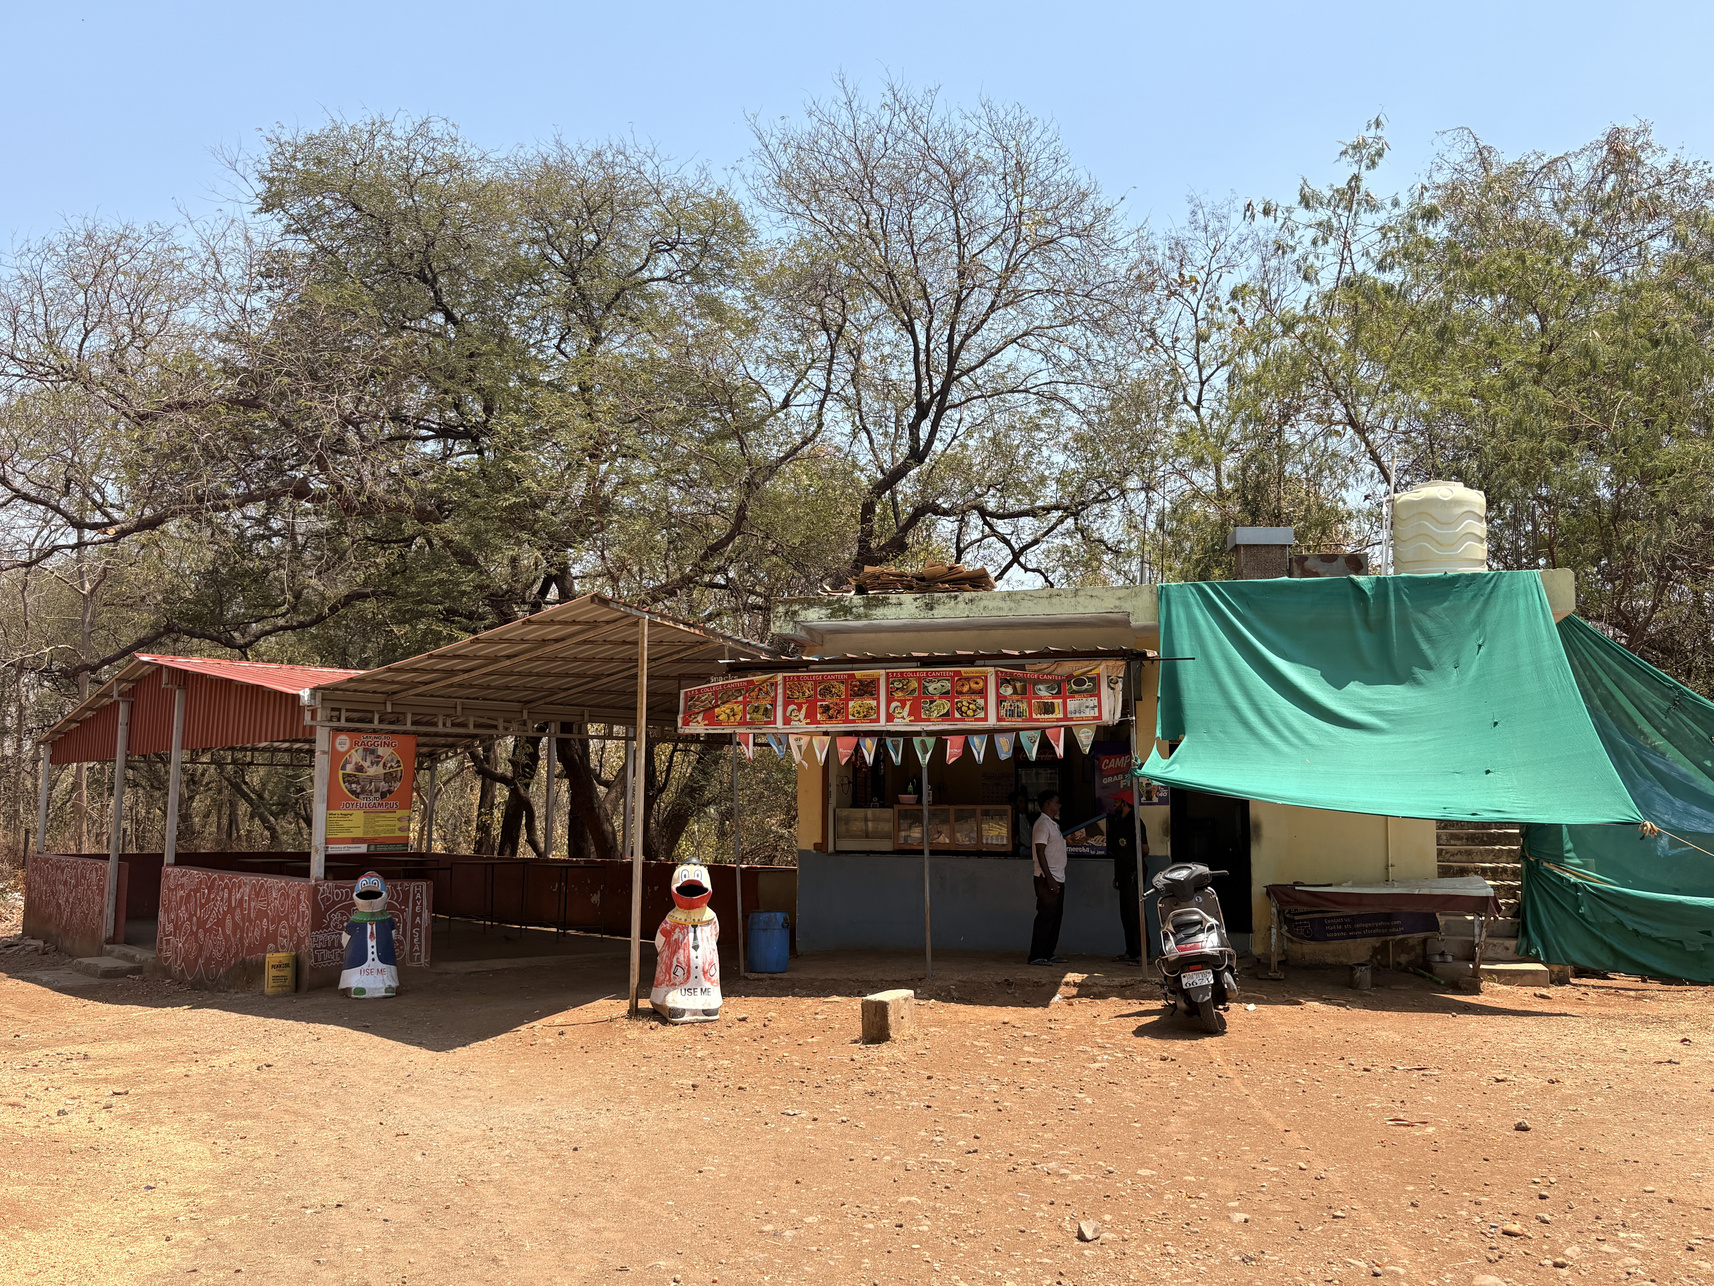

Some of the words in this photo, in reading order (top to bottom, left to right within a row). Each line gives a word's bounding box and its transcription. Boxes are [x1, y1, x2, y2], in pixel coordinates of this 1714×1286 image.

[1102, 774, 1123, 784] GRAB
[415, 916, 422, 924] A
[412, 928, 421, 961] SEAT
[680, 988, 698, 996] USE
[700, 988, 712, 996] ME
